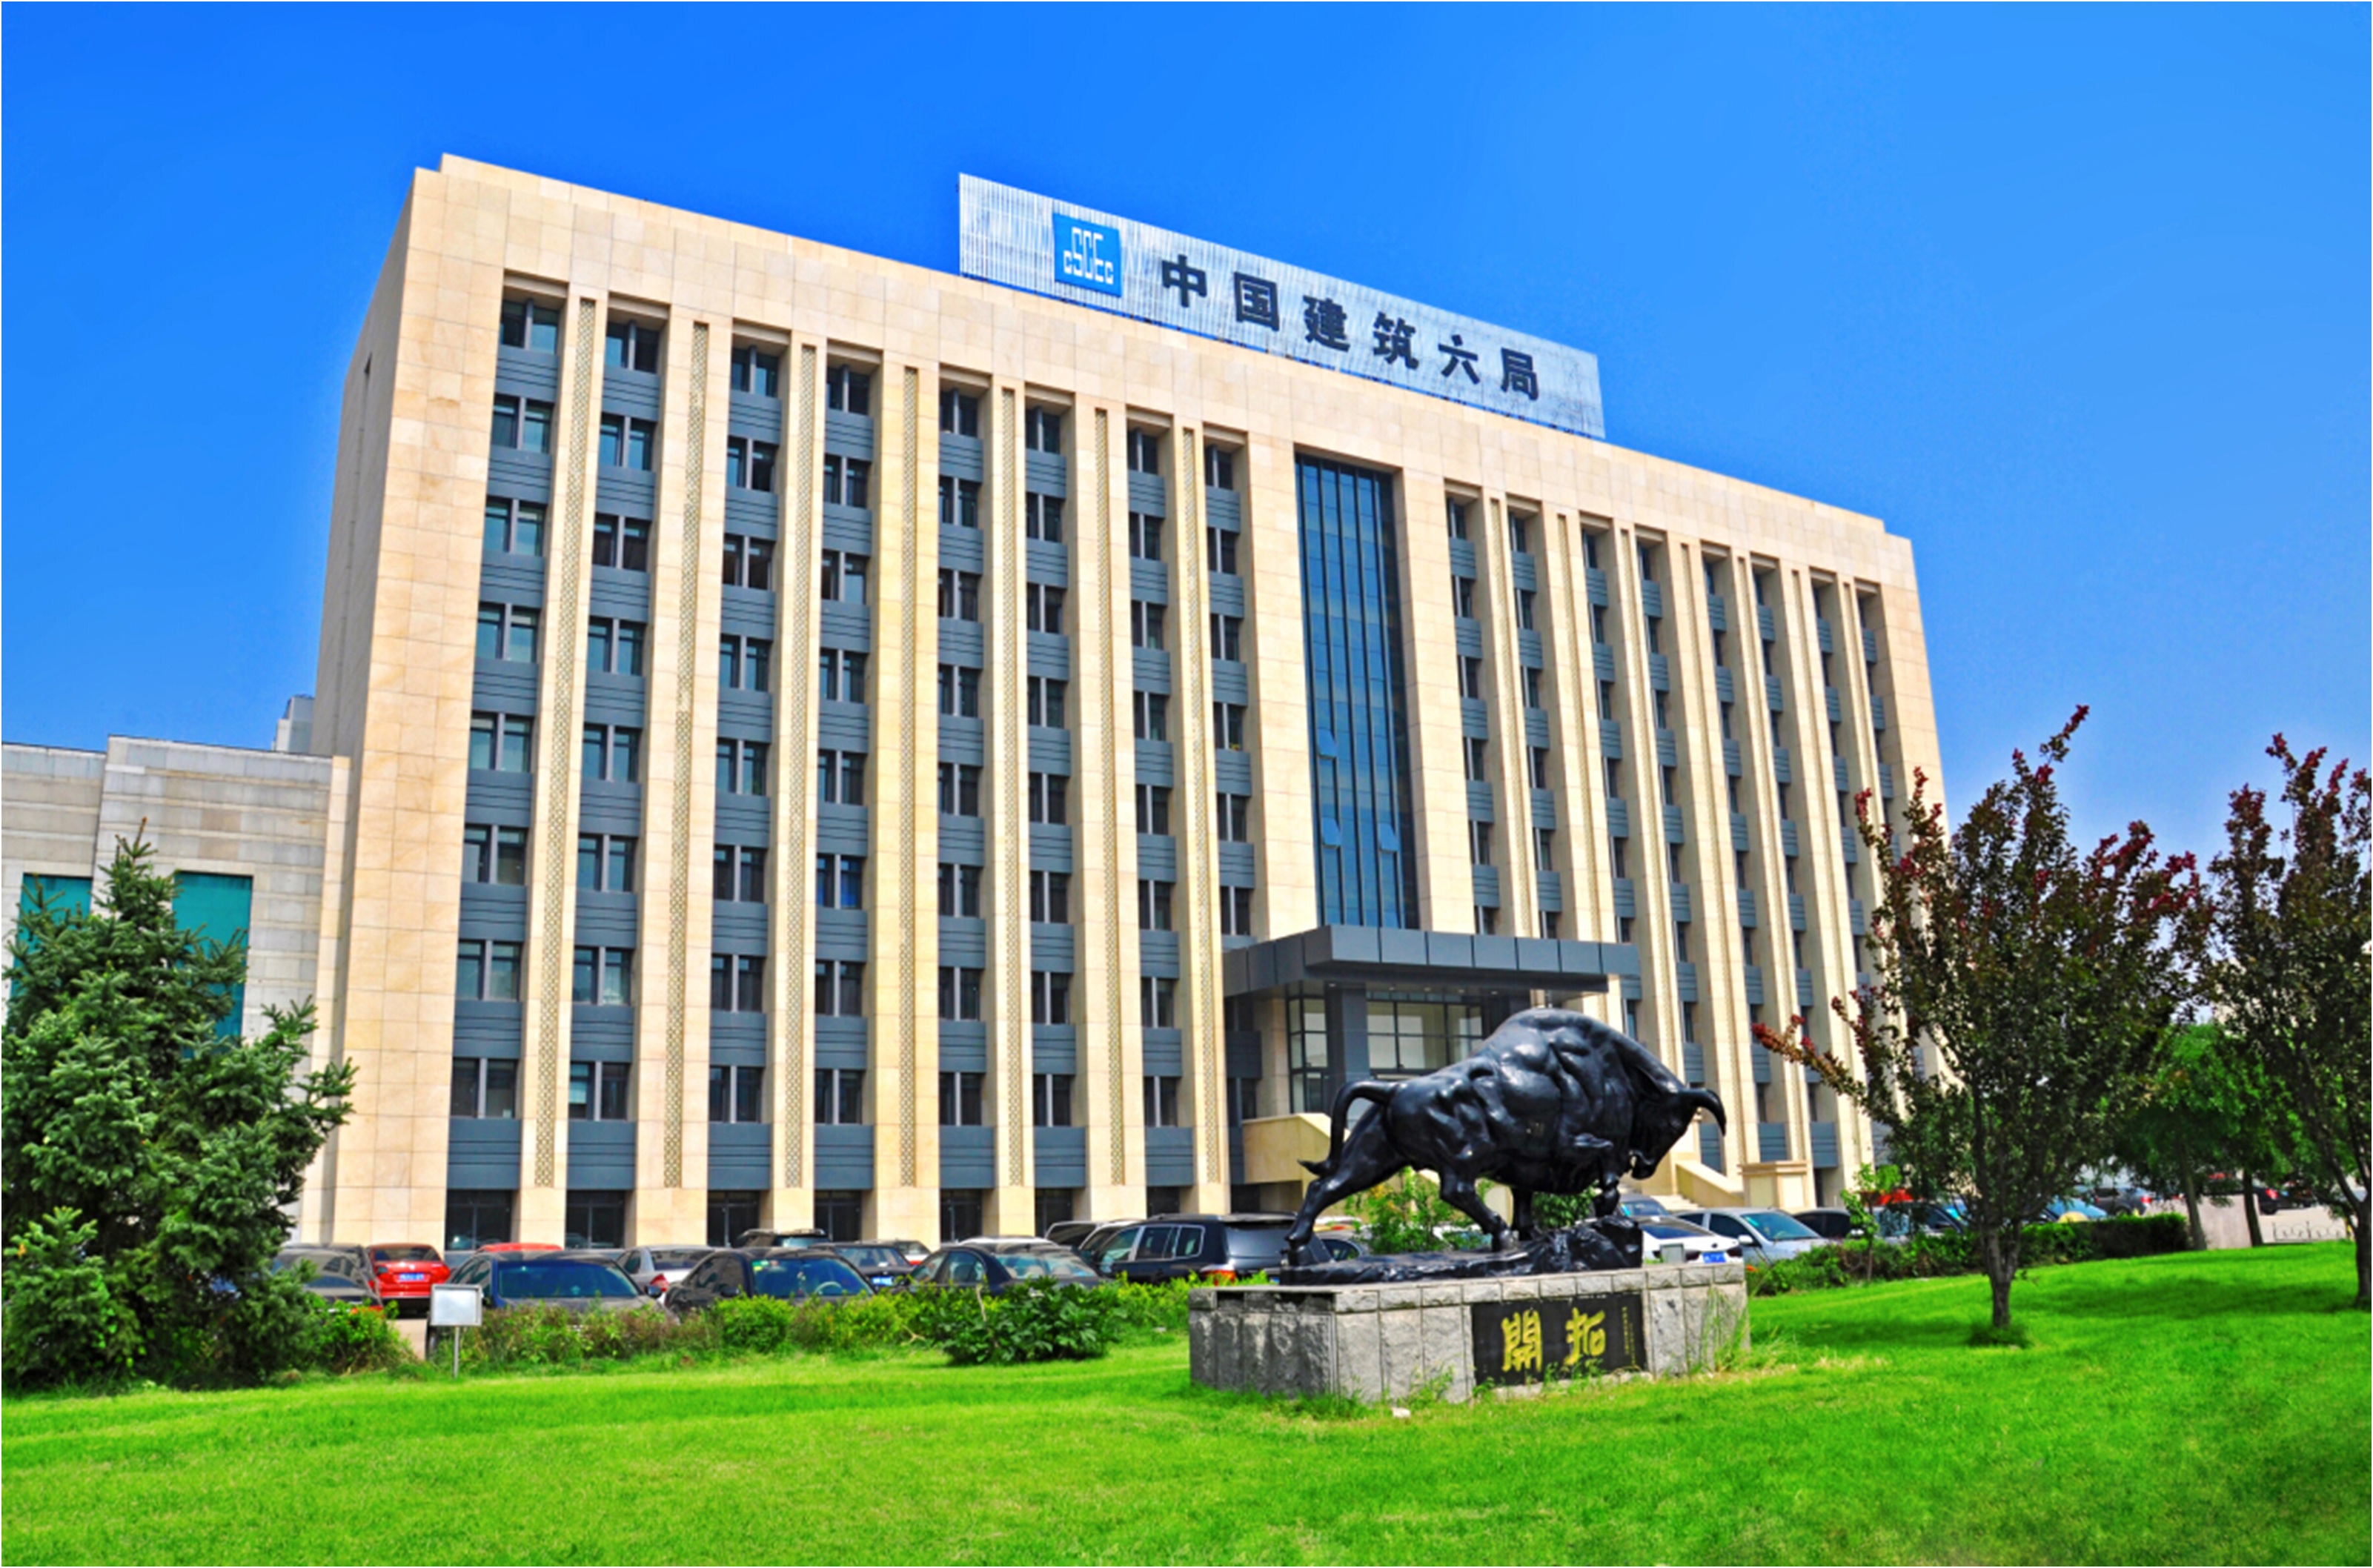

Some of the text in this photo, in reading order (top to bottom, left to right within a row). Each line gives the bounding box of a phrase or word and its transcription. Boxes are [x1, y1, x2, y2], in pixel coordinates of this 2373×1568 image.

[1161, 254, 1540, 401] 中国建筑六局
